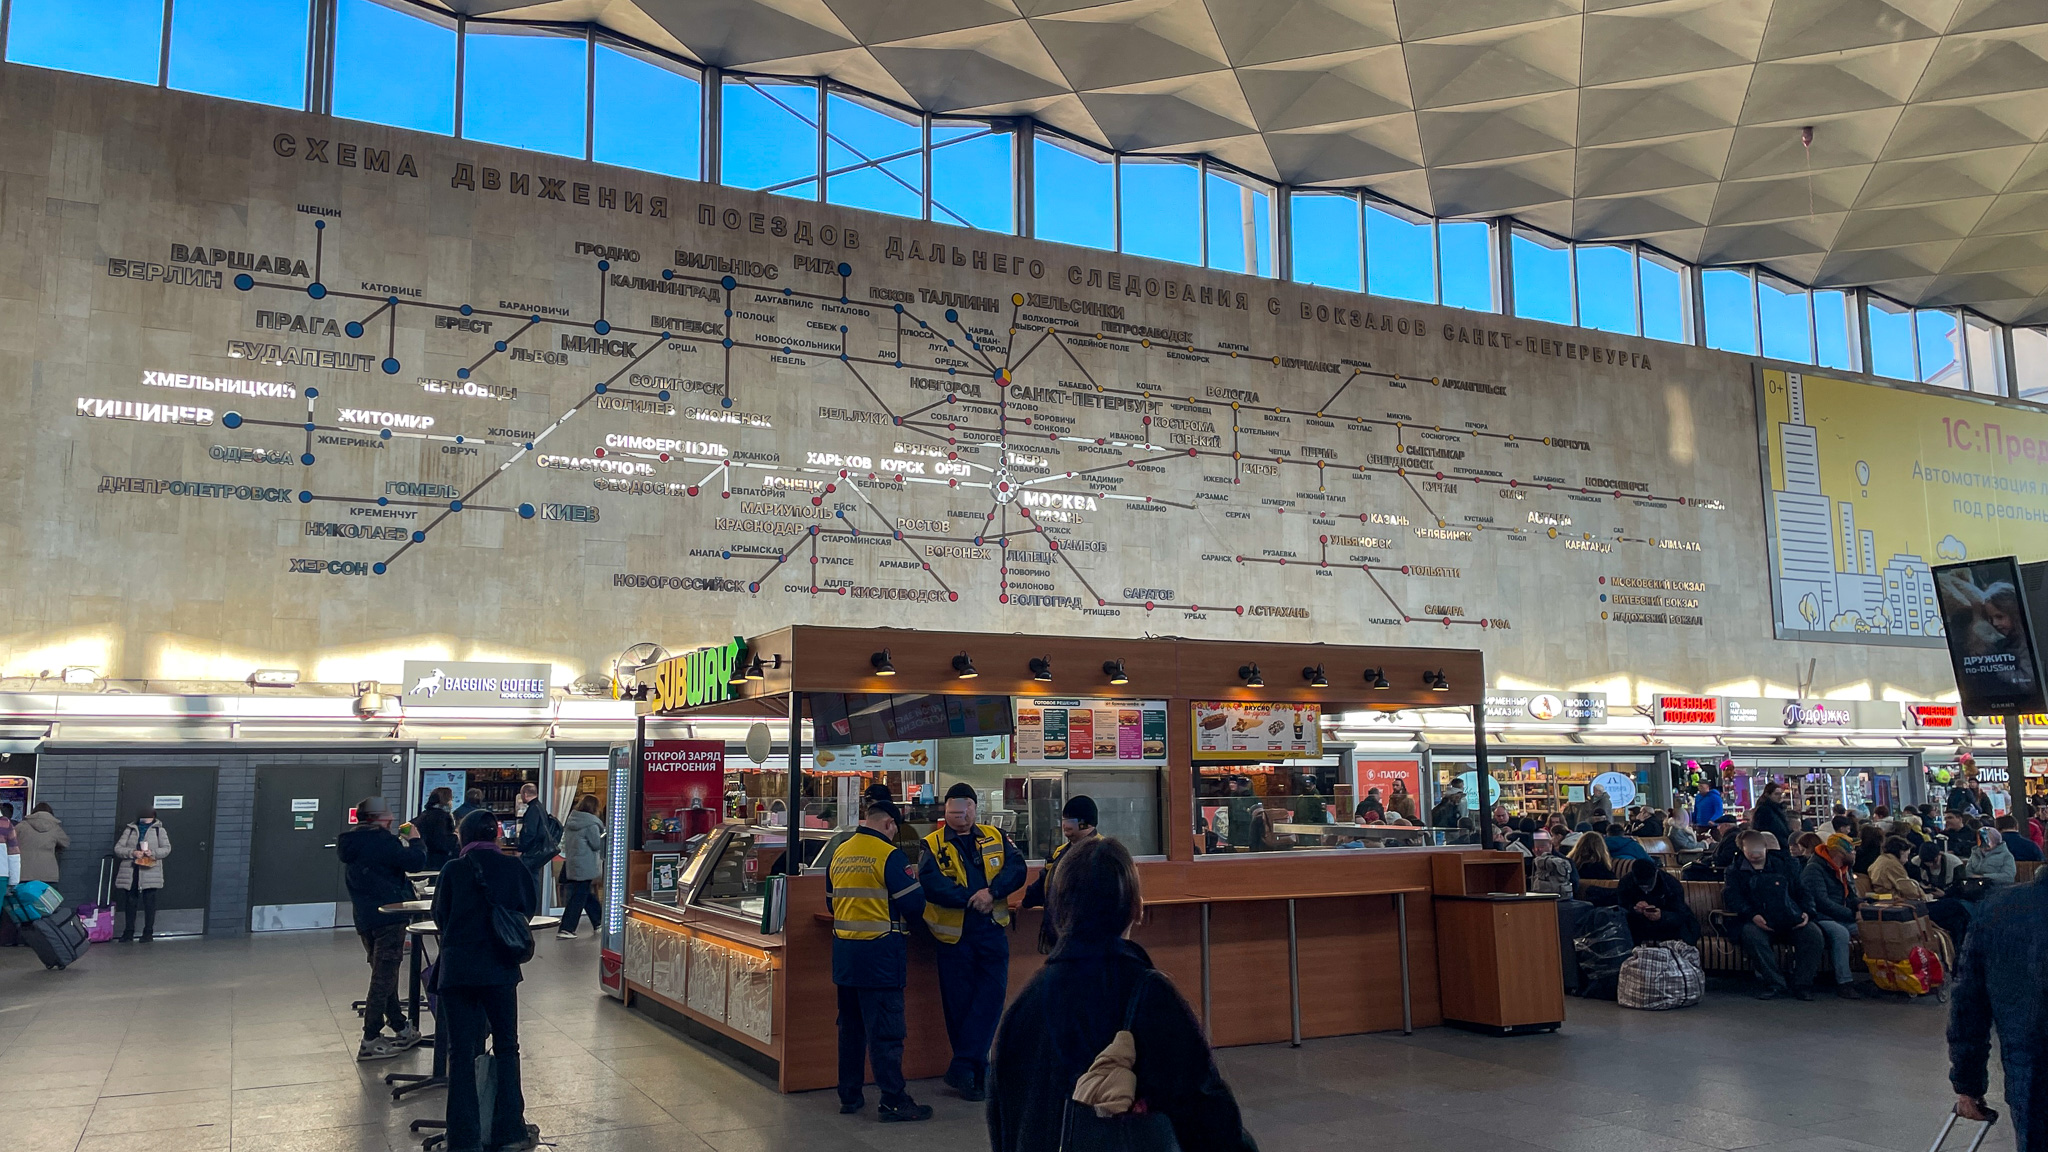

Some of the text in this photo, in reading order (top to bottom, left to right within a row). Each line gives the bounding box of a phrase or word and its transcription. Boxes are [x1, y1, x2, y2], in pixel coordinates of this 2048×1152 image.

[296, 204, 342, 218] ЩЕЦИН
[273, 133, 1653, 371] СХЕМА ДВИЖЕНИЯ ПОЕЗДОВ ДАЛЬНЕГО СЛЕДОВАНИЯ С ВОКЗАЛОВ САНКТ-ПЕТЕРБУРГА
[574, 241, 641, 263] ГРОДНО
[170, 243, 311, 279] ВАРШАВА
[674, 249, 780, 281] ВИЛЬНЮС
[793, 254, 839, 277] РИГА
[108, 257, 223, 290] БЕРЛИН
[361, 281, 423, 297] КАТОВИЦЕ
[610, 274, 721, 304] КАЛИНИНГРАД
[869, 286, 915, 304] ПСКОВ
[754, 293, 814, 310] ДАУГАВПИЛС
[918, 287, 1000, 313] ТАЛЛИНН
[1027, 292, 1125, 320] ХЕЛЬСИНКИ
[499, 300, 570, 317] БАРАНОВИЧИ
[735, 310, 776, 323] ПОЛОЦК
[821, 304, 870, 318] ПЫТАЛОВО
[255, 310, 342, 338] ПРАГА
[434, 314, 493, 335] БРЕСТ
[650, 314, 725, 337] ВИТЕБСК
[806, 320, 838, 332] СЕБЕЖ
[1014, 322, 1046, 334] ВЫБОРГ
[1022, 313, 1080, 328] ВОЛХОВСТРОЙ
[899, 328, 935, 341] ПЛЮССА
[968, 326, 995, 337] НАРВА
[1101, 320, 1193, 344] ПЕТРОЗАВОДСК
[560, 333, 638, 360] МИНСК
[667, 342, 698, 354] ОРША
[928, 342, 949, 353] ЛУГА
[975, 335, 1001, 346] ИВАН-
[1066, 337, 1130, 353] ЛОДЕЙНОЕ ПОЛЕ
[227, 340, 376, 373] БУДАПЕШТ
[509, 347, 569, 366] ЛЬВОВ
[980, 344, 1008, 356] ГОРОД
[1166, 351, 1211, 364] БЕЛОМОРСК
[770, 354, 807, 367] НЕВЕЛЬ
[934, 356, 970, 369] ОРЕДЕЖ
[1282, 357, 1342, 375] МУРМАНСК
[1340, 358, 1372, 369] НЯНДОМА
[142, 370, 297, 399] ХМЕЛЬНИЦКИЙ
[416, 377, 518, 402] ЧЕРНОВЦЫ
[629, 373, 726, 397] СОЛИГОРСК
[909, 376, 982, 398] НОВГОРОД
[1058, 380, 1093, 391] БАБАЕВО
[1441, 378, 1508, 397] АРХАНГЕЛЬСК
[1768, 379, 1784, 395] 0+
[1010, 384, 1164, 416] САНКТ-ПЕТЕРБУРГ
[1206, 385, 1261, 404] ВОЛОГДА
[75, 397, 215, 427] КИШИНЕВ
[596, 395, 676, 416] МОГИЛЕВ
[962, 404, 999, 416] УГЛОВКА
[1007, 401, 1039, 412] ЧУДОВО
[1170, 403, 1213, 416] ЧЕРЕПОВЕЦ
[337, 406, 435, 431] ЖИТОМИР
[684, 406, 773, 428] СМОЛЕНСК
[1033, 413, 1076, 425] БОРОВИЧИ
[1306, 418, 1336, 429] КОНОША
[1386, 411, 1413, 422] МИКУНЬ
[1033, 423, 1071, 434] СОНКОВО
[1153, 416, 1216, 434] КОСТРОМА
[1239, 426, 1281, 438] КОТЕЛЬНИЧ
[1347, 423, 1373, 433] КОТЛАС
[1464, 421, 1489, 431] ПЕЧОРА
[487, 427, 536, 440] ЖЛОБИН
[1109, 431, 1145, 442] ИВАНОВО
[1169, 432, 1222, 449] ГОРЬКИЙ
[1420, 432, 1461, 443] СОСНОГОРСК
[316, 434, 386, 450] ЖМЕРИНКА
[605, 433, 730, 458] СИМФЕРОПОЛЬ
[893, 441, 948, 459] БРЯНСК
[1007, 443, 1062, 456] ЛИХОСЛАВЛЬ
[1551, 437, 1592, 452] ВОРКУТА
[208, 444, 295, 466] ОДЕССА
[441, 445, 478, 457] ОВРУЧ
[732, 450, 781, 463] ДЖАНКОЙ
[1301, 445, 1339, 460] ПЕРМЬ
[536, 454, 657, 477] СЕВАСТОПОЛЬ
[806, 451, 873, 470] ХАРЬКОВ
[880, 458, 926, 475] КУРСК
[1366, 453, 1435, 471] СВЕРДЛОВСК
[761, 474, 825, 494] ДОНЕЦК
[1912, 459, 2037, 496] Автоматизация
[97, 474, 293, 504] ДНЕПРОПЕТРОВСК
[385, 480, 461, 500] ГОМЕЛЬ
[593, 476, 686, 497] ФЕОДОСИЯ
[731, 486, 787, 499] ЕВПАТОРИЯ
[1023, 490, 1098, 513] МОСКВА
[1296, 491, 1347, 503] НИЖНИЙ ТАГИЛ
[349, 506, 419, 520] КРЕМЕНЧУГ
[540, 502, 601, 524] КИЕВ
[740, 500, 834, 520] МАРИУПОЛЬ
[1953, 498, 1984, 519] под
[714, 516, 805, 536] КРАСНОДАР
[896, 517, 951, 533] РОСТОВ
[1370, 512, 1411, 528] КАЗАНЬ
[305, 521, 408, 542] НИКОЛАЕВ
[1413, 527, 1474, 543] ЧЕЛЯБИНСК
[821, 534, 892, 547] СТАРОМИНСКАЯ
[1057, 538, 1108, 554] ТАМБОВ
[1329, 533, 1393, 551] УЛЬЯНОВСК
[689, 548, 722, 559] АНАПА
[730, 544, 784, 555] КРЫМСКАЯ
[924, 544, 992, 561] ВОРОНЕЖ
[1005, 550, 1060, 566] ЛИПЕЦК
[288, 558, 369, 576] ХЕРСОН
[1409, 564, 1462, 579] ТОЛЬЯТТИ
[613, 572, 746, 594] НОВОРОССИЙСК
[1611, 576, 1706, 592] МОСКОВСКИЙ ВОКЗАЛ
[850, 585, 948, 604] КИСЛОВОДСК
[1009, 593, 1083, 611] ВОЛГОГРАД
[1424, 603, 1465, 617] САМАРА
[1664, 597, 1699, 609] ВОКЗАЛ
[1247, 605, 1311, 619] АСТРАХАНЬ
[1963, 653, 2016, 666] ДРУЖИТЬ
[444, 677, 545, 692] BAGGINS COFFEE
[652, 641, 740, 712] SUBWAY
[1485, 696, 1528, 706] ИРМЕННЫЙ
[1564, 699, 1605, 709] ШОКОЛАД
[1661, 696, 1717, 710] ИМЕННЫЕ
[1486, 707, 1523, 717] МАГАЗИН
[1565, 709, 1604, 719] КОНФЕТЫ
[1663, 710, 1716, 724] ПОДАРКИ
[1783, 702, 1851, 726] Подружка
[643, 750, 722, 763] ОТКРОЙ ЗАРЯД
[647, 762, 716, 772] НАСТРОЕНИЯ
